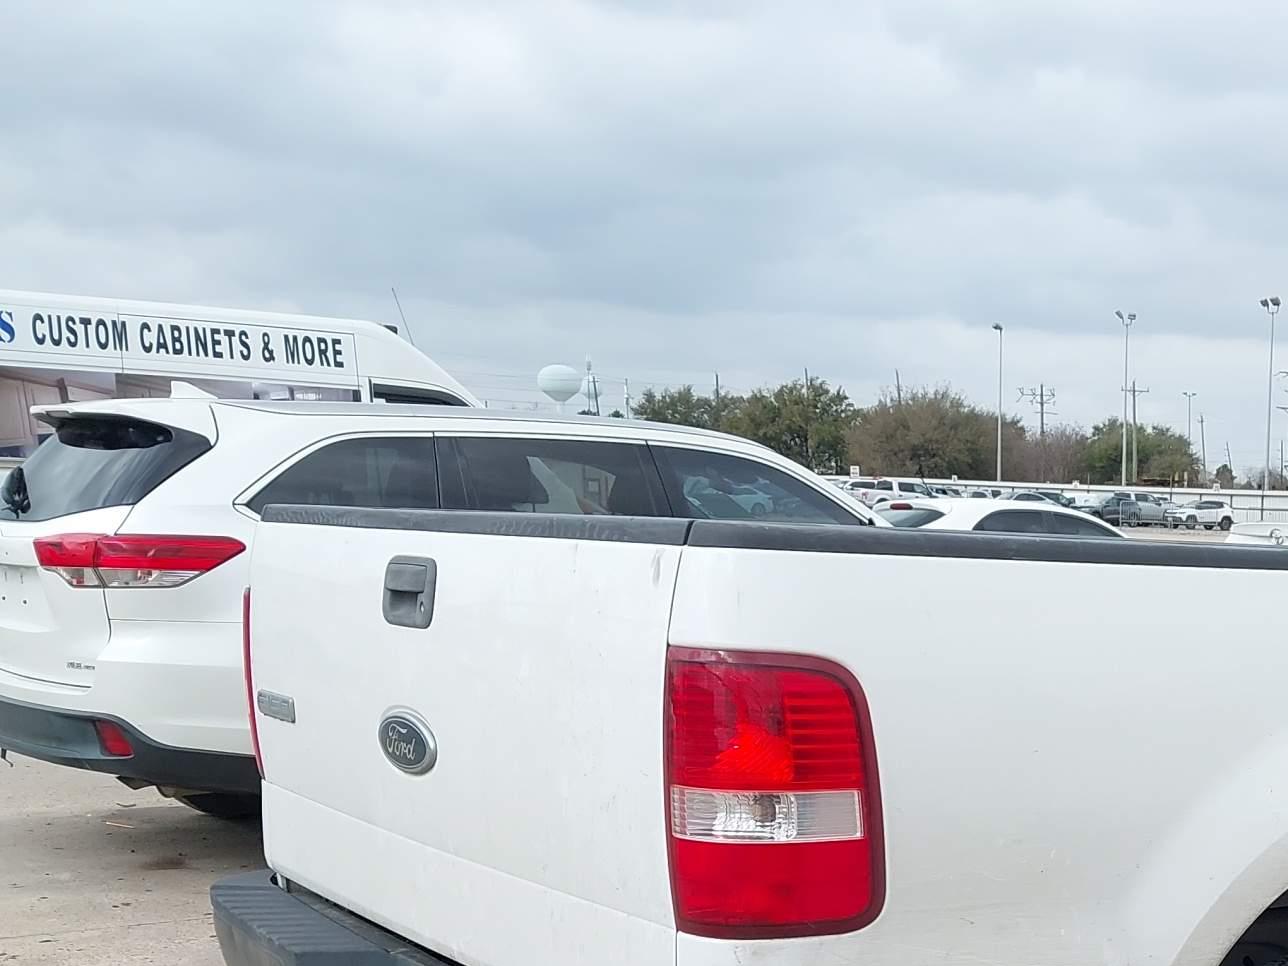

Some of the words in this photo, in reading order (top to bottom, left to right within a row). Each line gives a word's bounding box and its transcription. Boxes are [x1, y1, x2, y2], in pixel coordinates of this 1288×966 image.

[31, 312, 129, 352] CUSTOM
[139, 322, 251, 361] CABINETS
[261, 333, 275, 363] &
[284, 334, 345, 369] MORE
[386, 723, 416, 761] Ford
